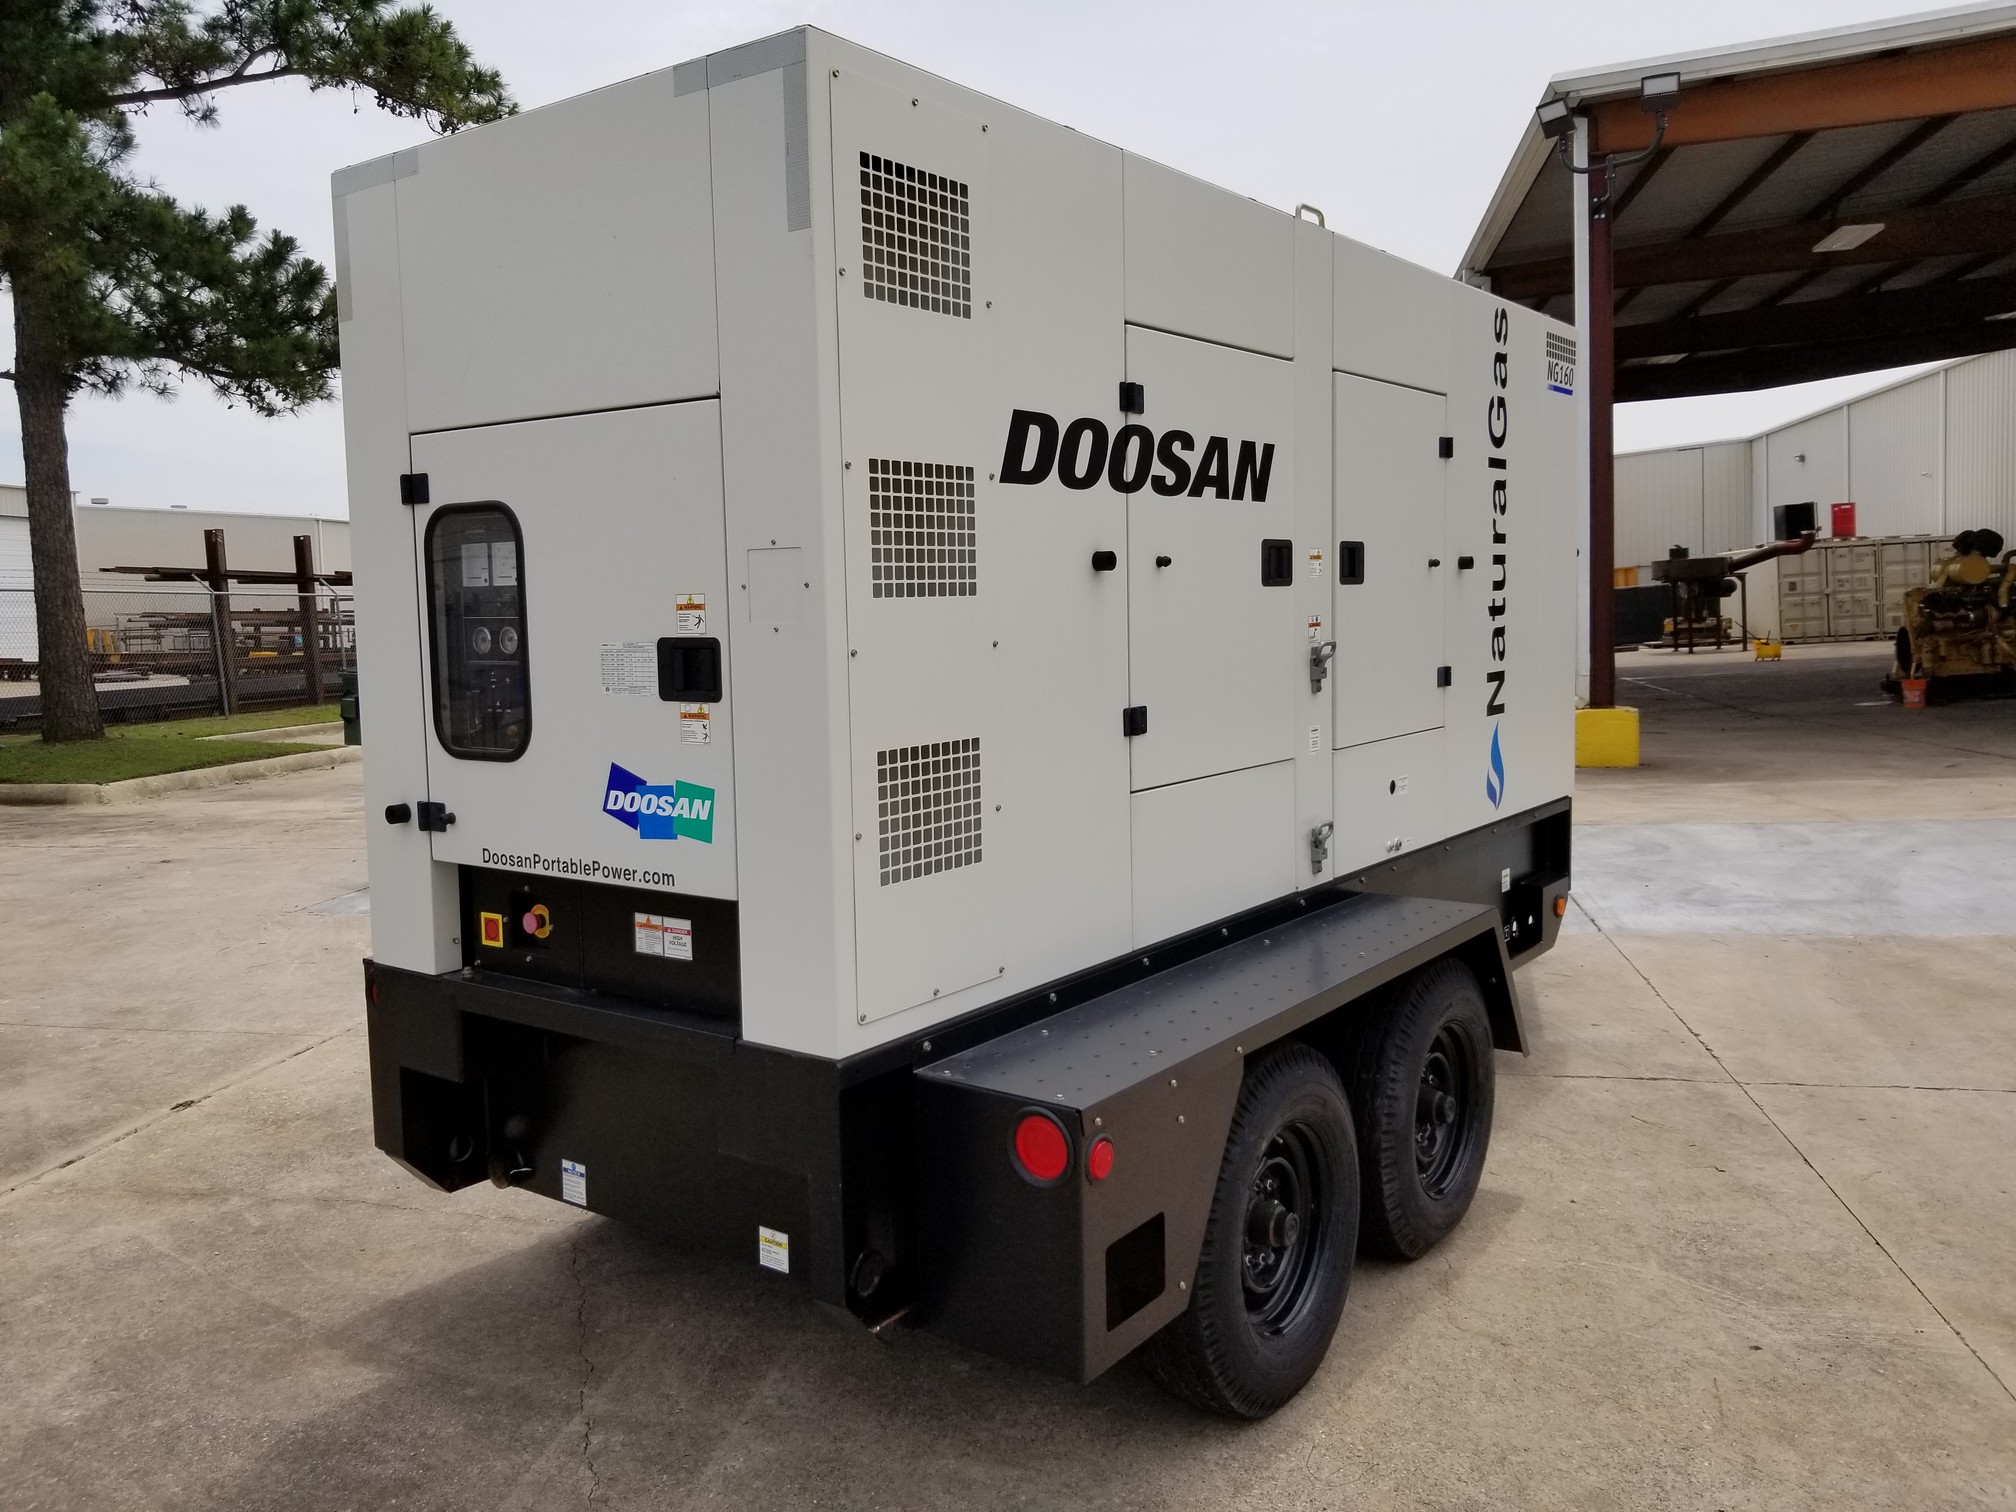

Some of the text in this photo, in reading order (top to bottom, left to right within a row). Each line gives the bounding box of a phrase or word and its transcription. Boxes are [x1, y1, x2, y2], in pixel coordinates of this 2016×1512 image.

[1547, 360, 1574, 387] NG160
[998, 409, 1275, 503] DOOSAN
[606, 790, 712, 821] DOOSAN
[482, 848, 676, 887] DoosanPortablePower.com
[669, 940, 688, 948] VOLTAGE
[764, 1237, 783, 1248] CAUTION
